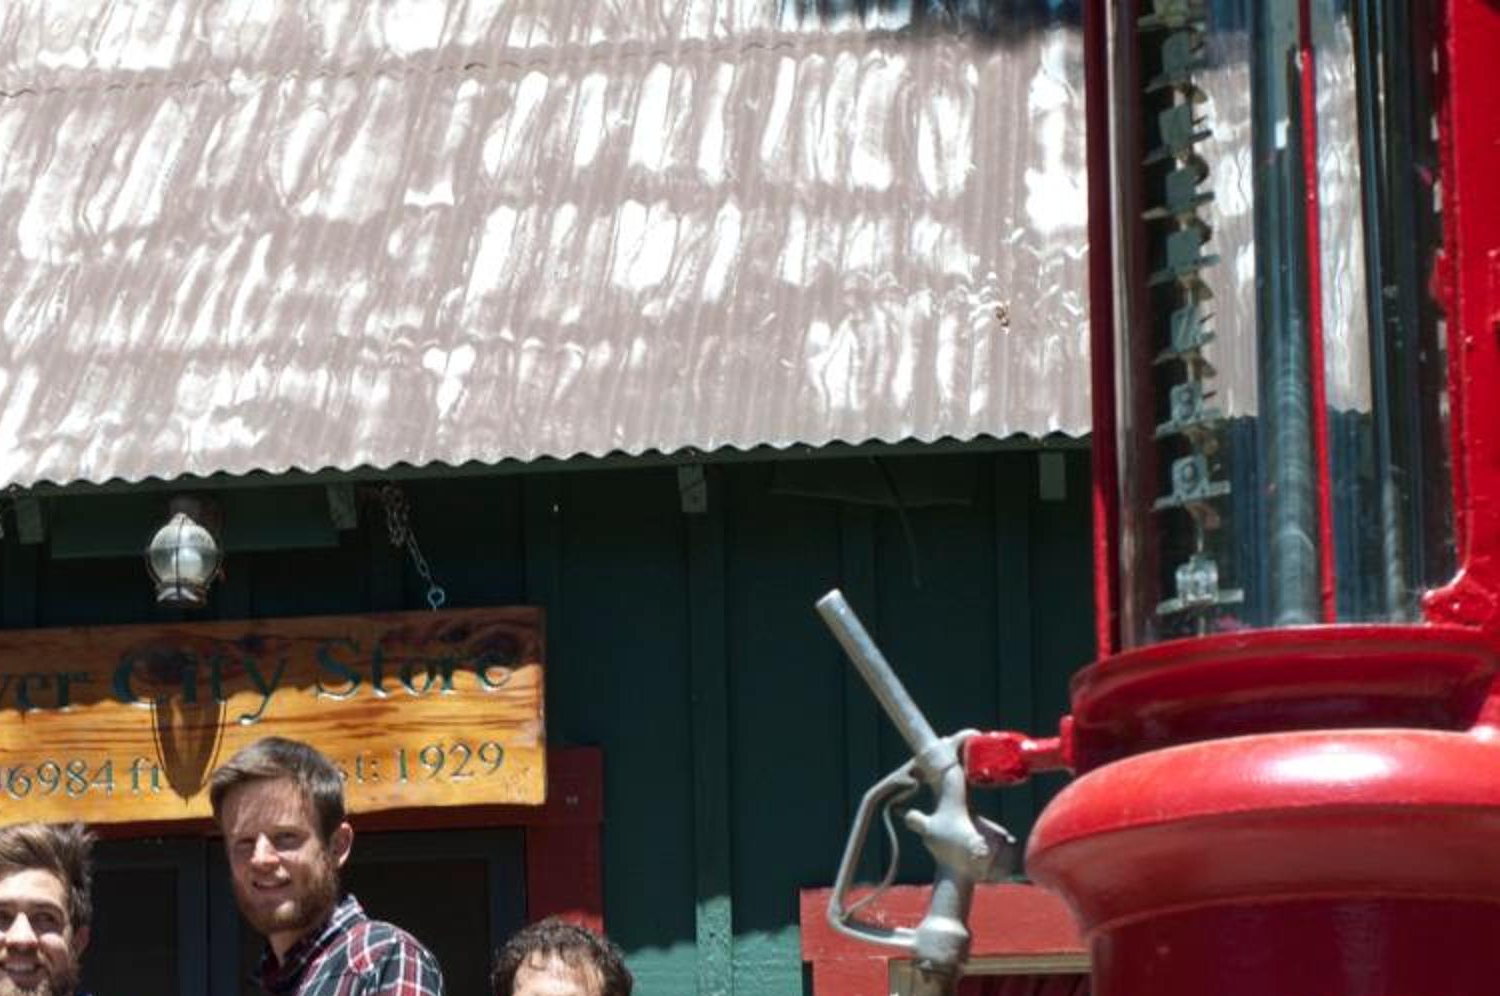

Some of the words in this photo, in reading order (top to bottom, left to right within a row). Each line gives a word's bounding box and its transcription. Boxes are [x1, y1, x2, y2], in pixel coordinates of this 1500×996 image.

[112, 642, 290, 726] City
[316, 637, 514, 701] Store
[6, 756, 116, 801] 6984
[130, 756, 162, 794] ft
[398, 741, 505, 783] 1929
